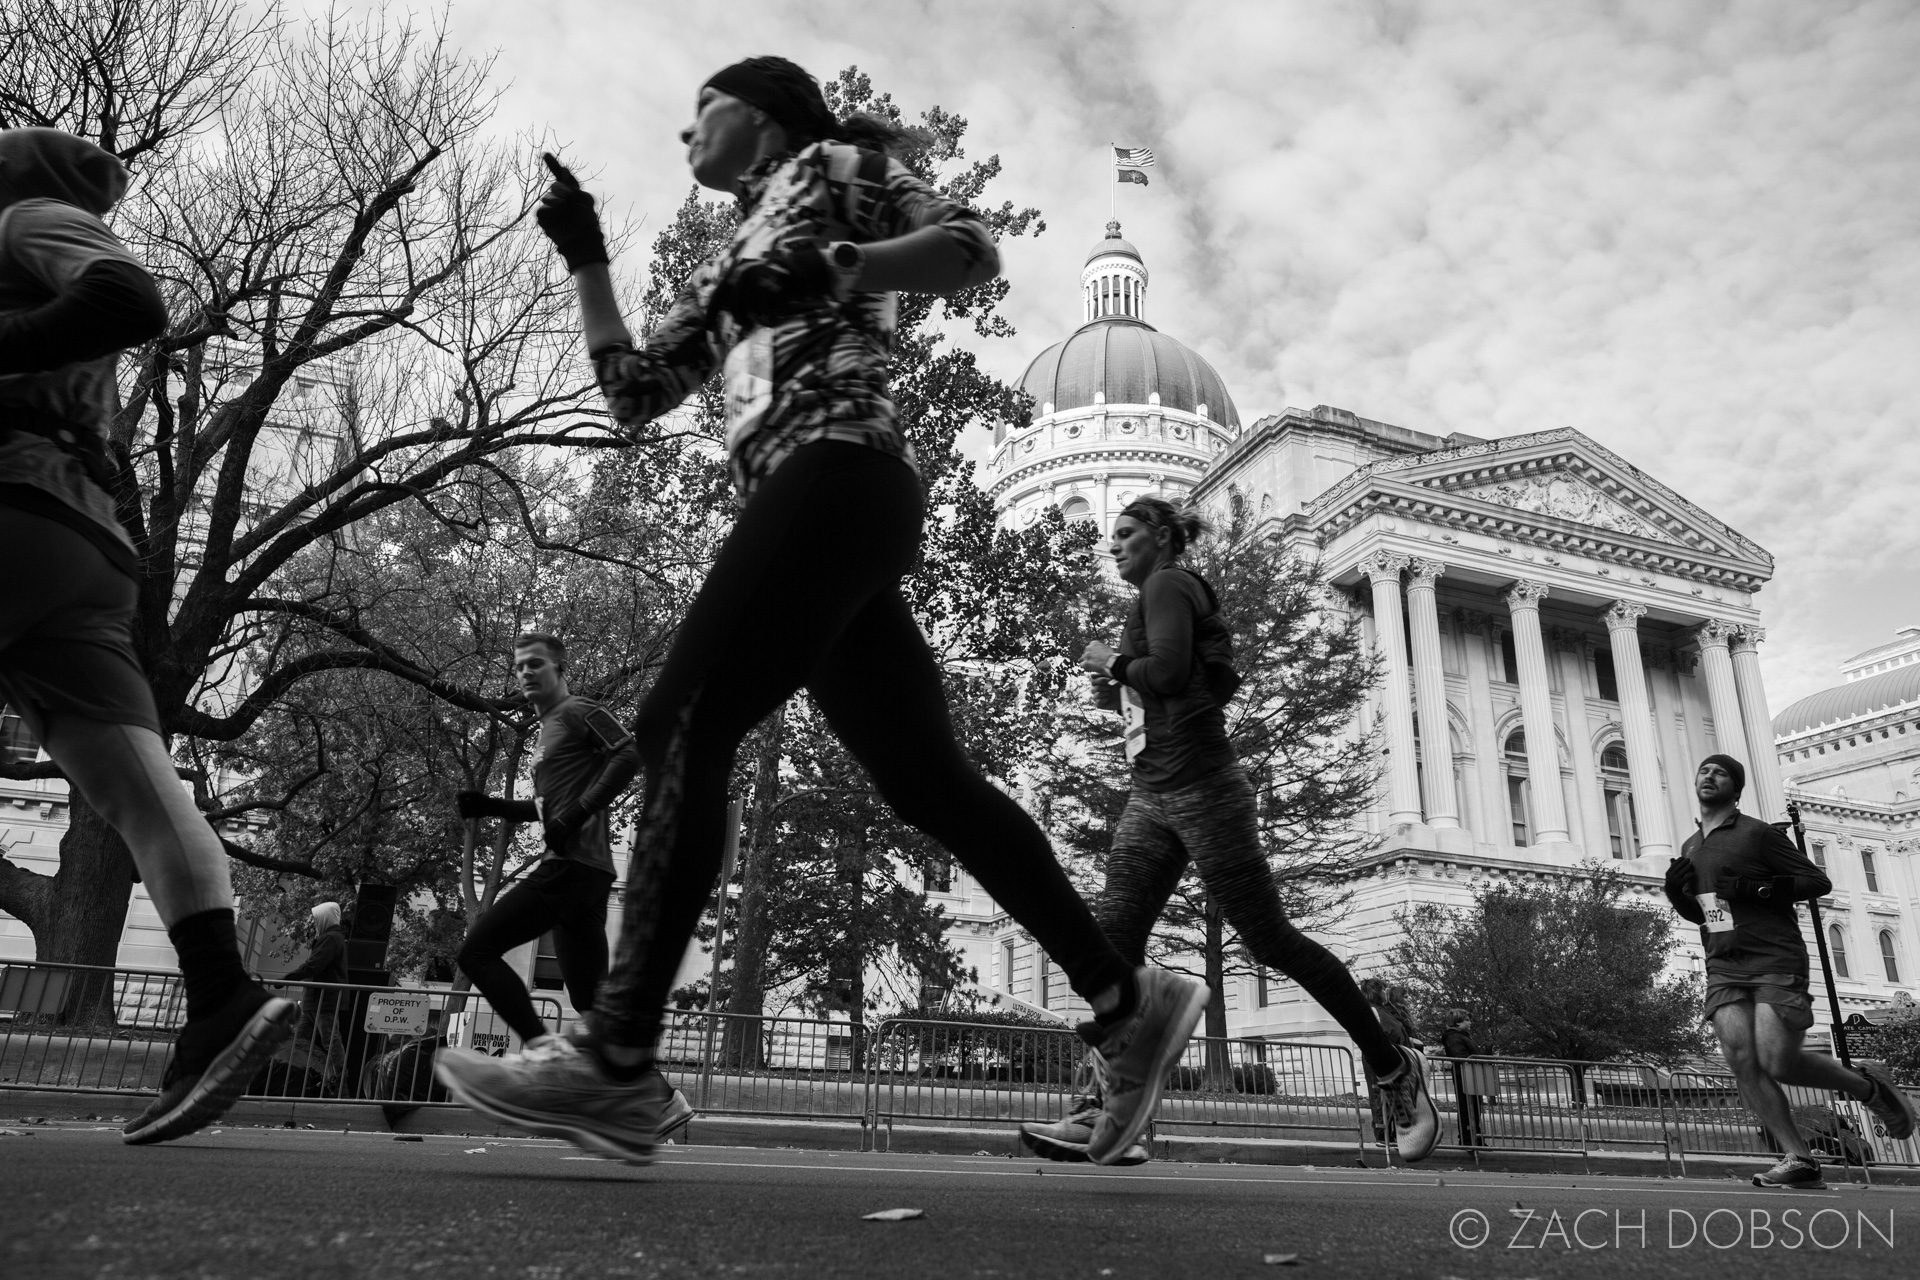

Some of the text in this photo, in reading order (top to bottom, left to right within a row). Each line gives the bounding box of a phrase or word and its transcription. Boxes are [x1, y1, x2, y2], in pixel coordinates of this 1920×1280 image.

[1706, 909, 1725, 922] 1592
[378, 998, 421, 1007] PROPERTY
[392, 1007, 405, 1015] OF
[1012, 1003, 1026, 1014] ULTRA
[384, 1015, 409, 1023] D.P.W.
